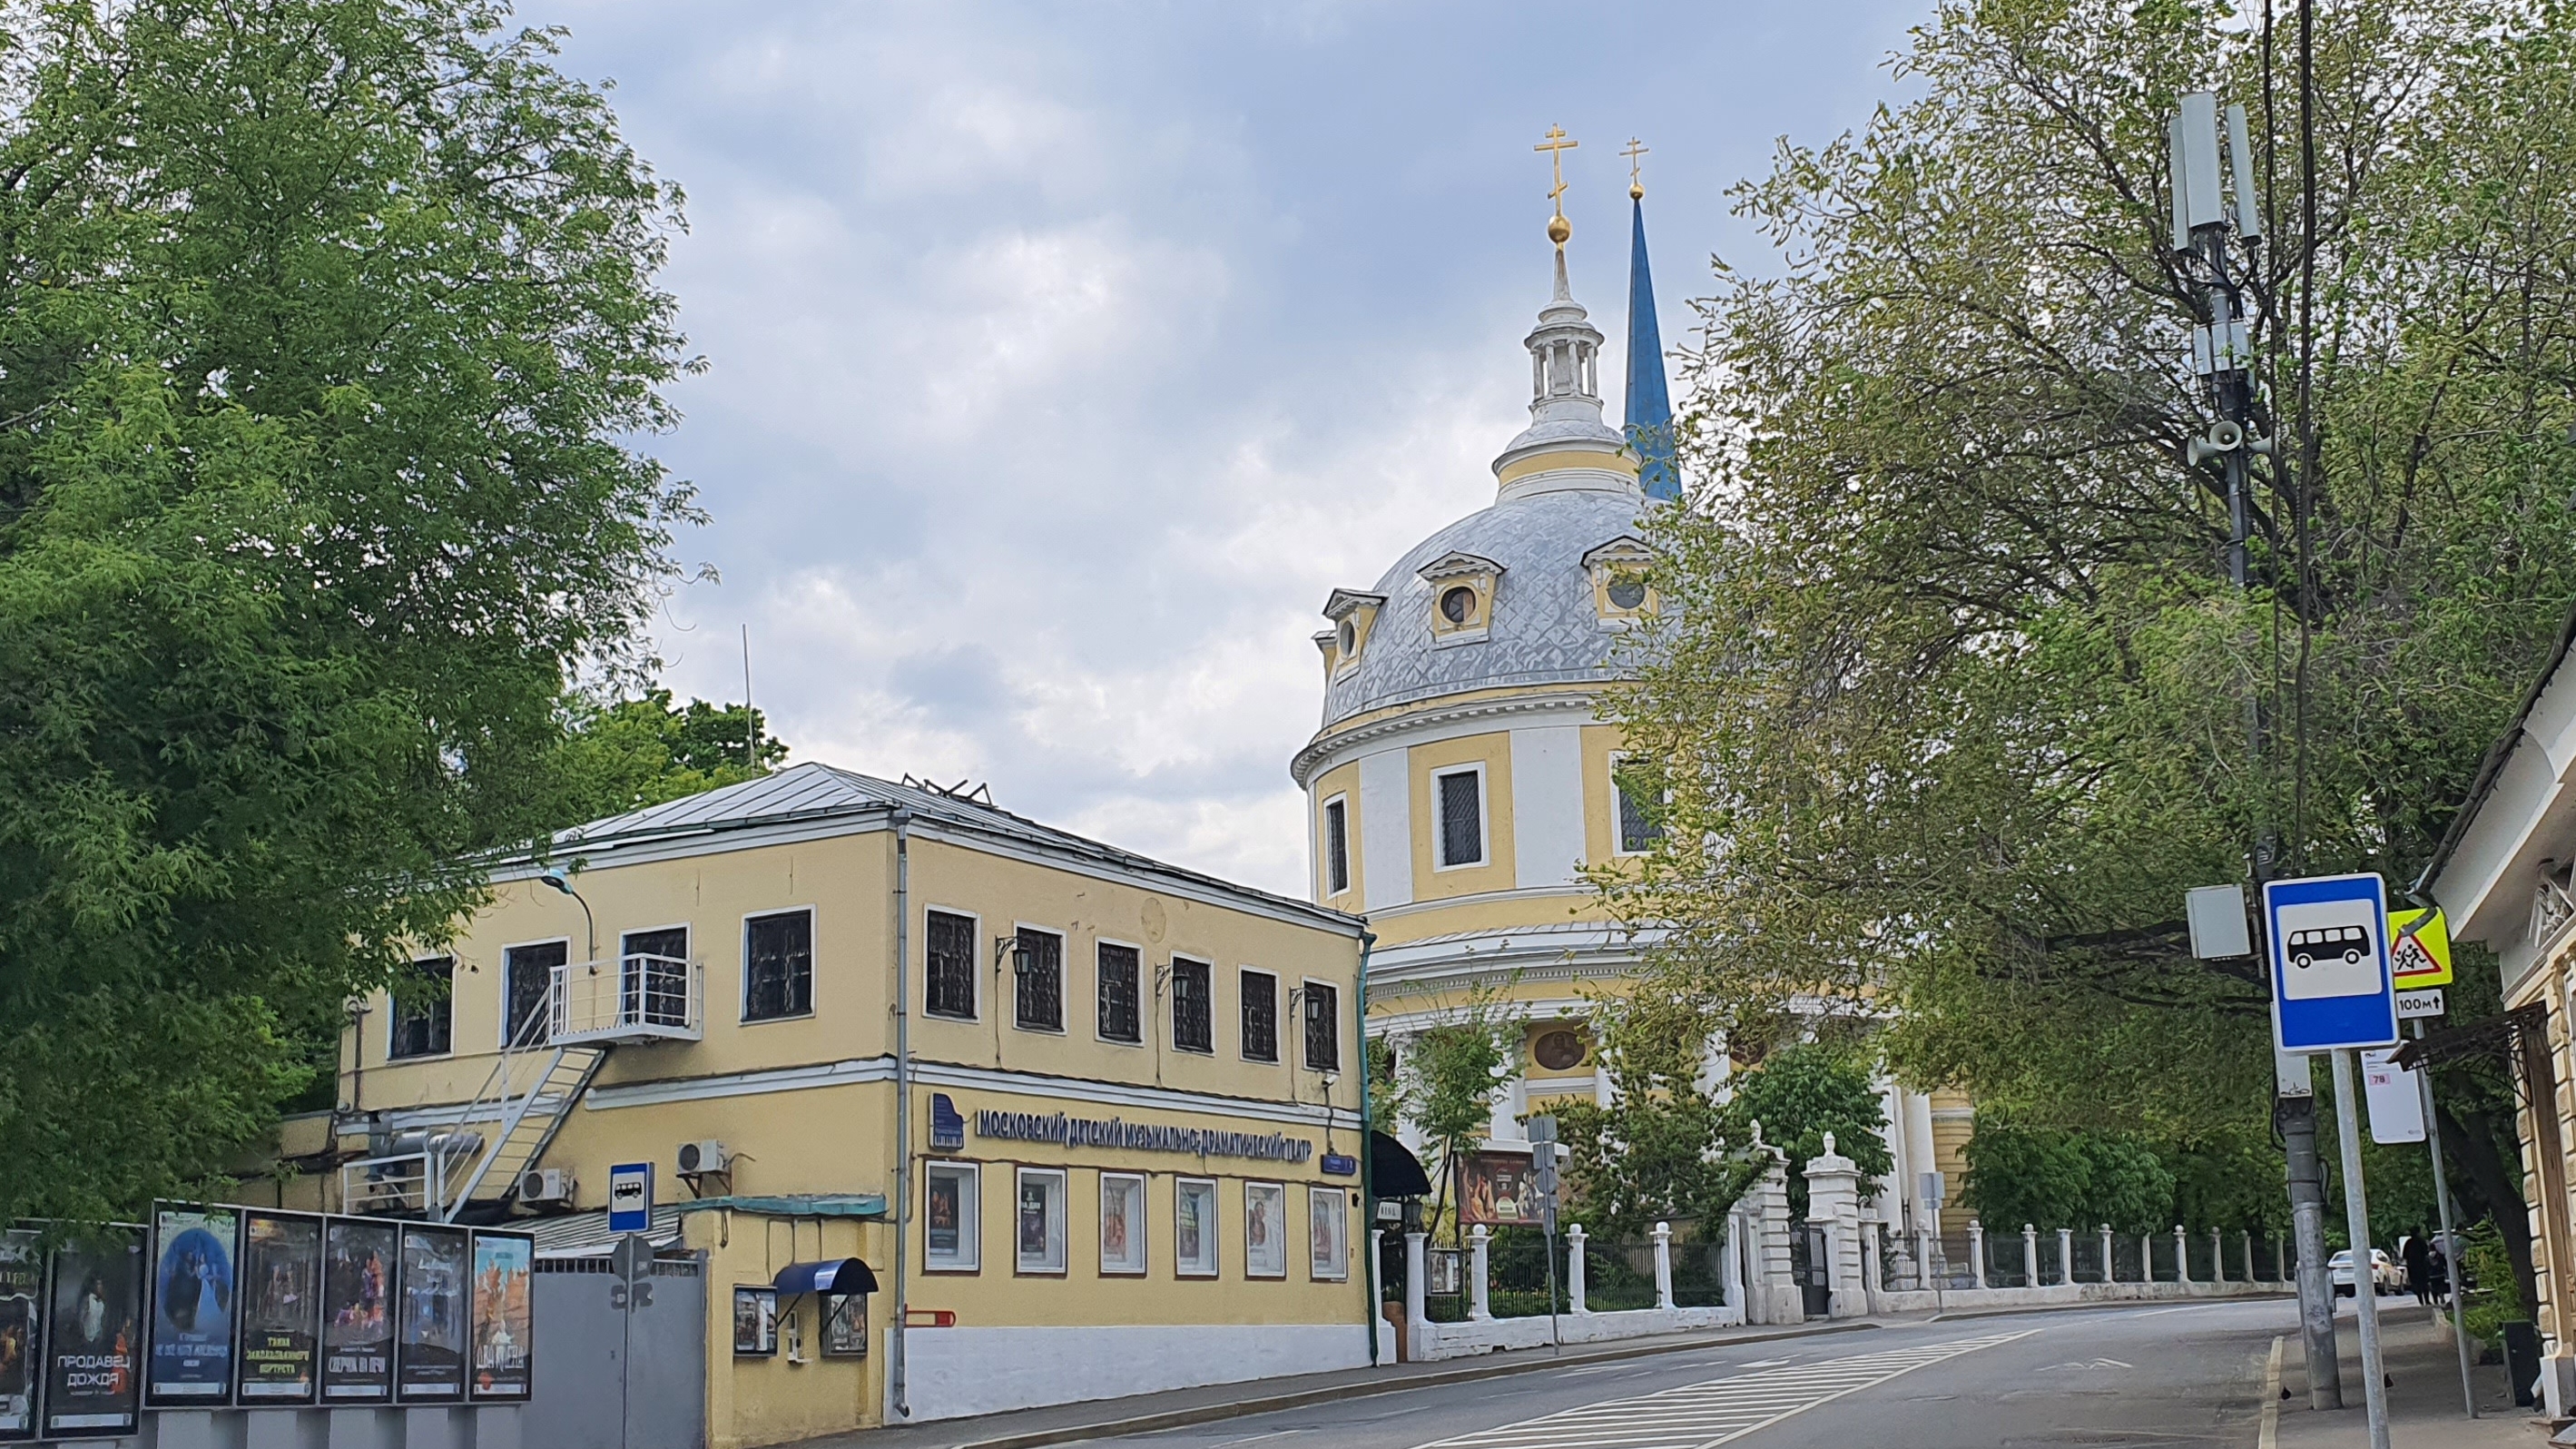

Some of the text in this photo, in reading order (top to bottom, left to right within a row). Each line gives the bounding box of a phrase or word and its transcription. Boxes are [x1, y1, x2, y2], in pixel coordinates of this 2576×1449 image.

[2373, 1075, 2385, 1084] 78
[978, 1109, 1067, 1141] МОСКОВСКИЙ
[1067, 1116, 1123, 1148] ДЕТСКИЙ
[1285, 1138, 1313, 1161] ТЕАТР
[57, 1355, 131, 1372] ПРОДАВЕЦ
[67, 1372, 119, 1388] ДОЖДЯ
